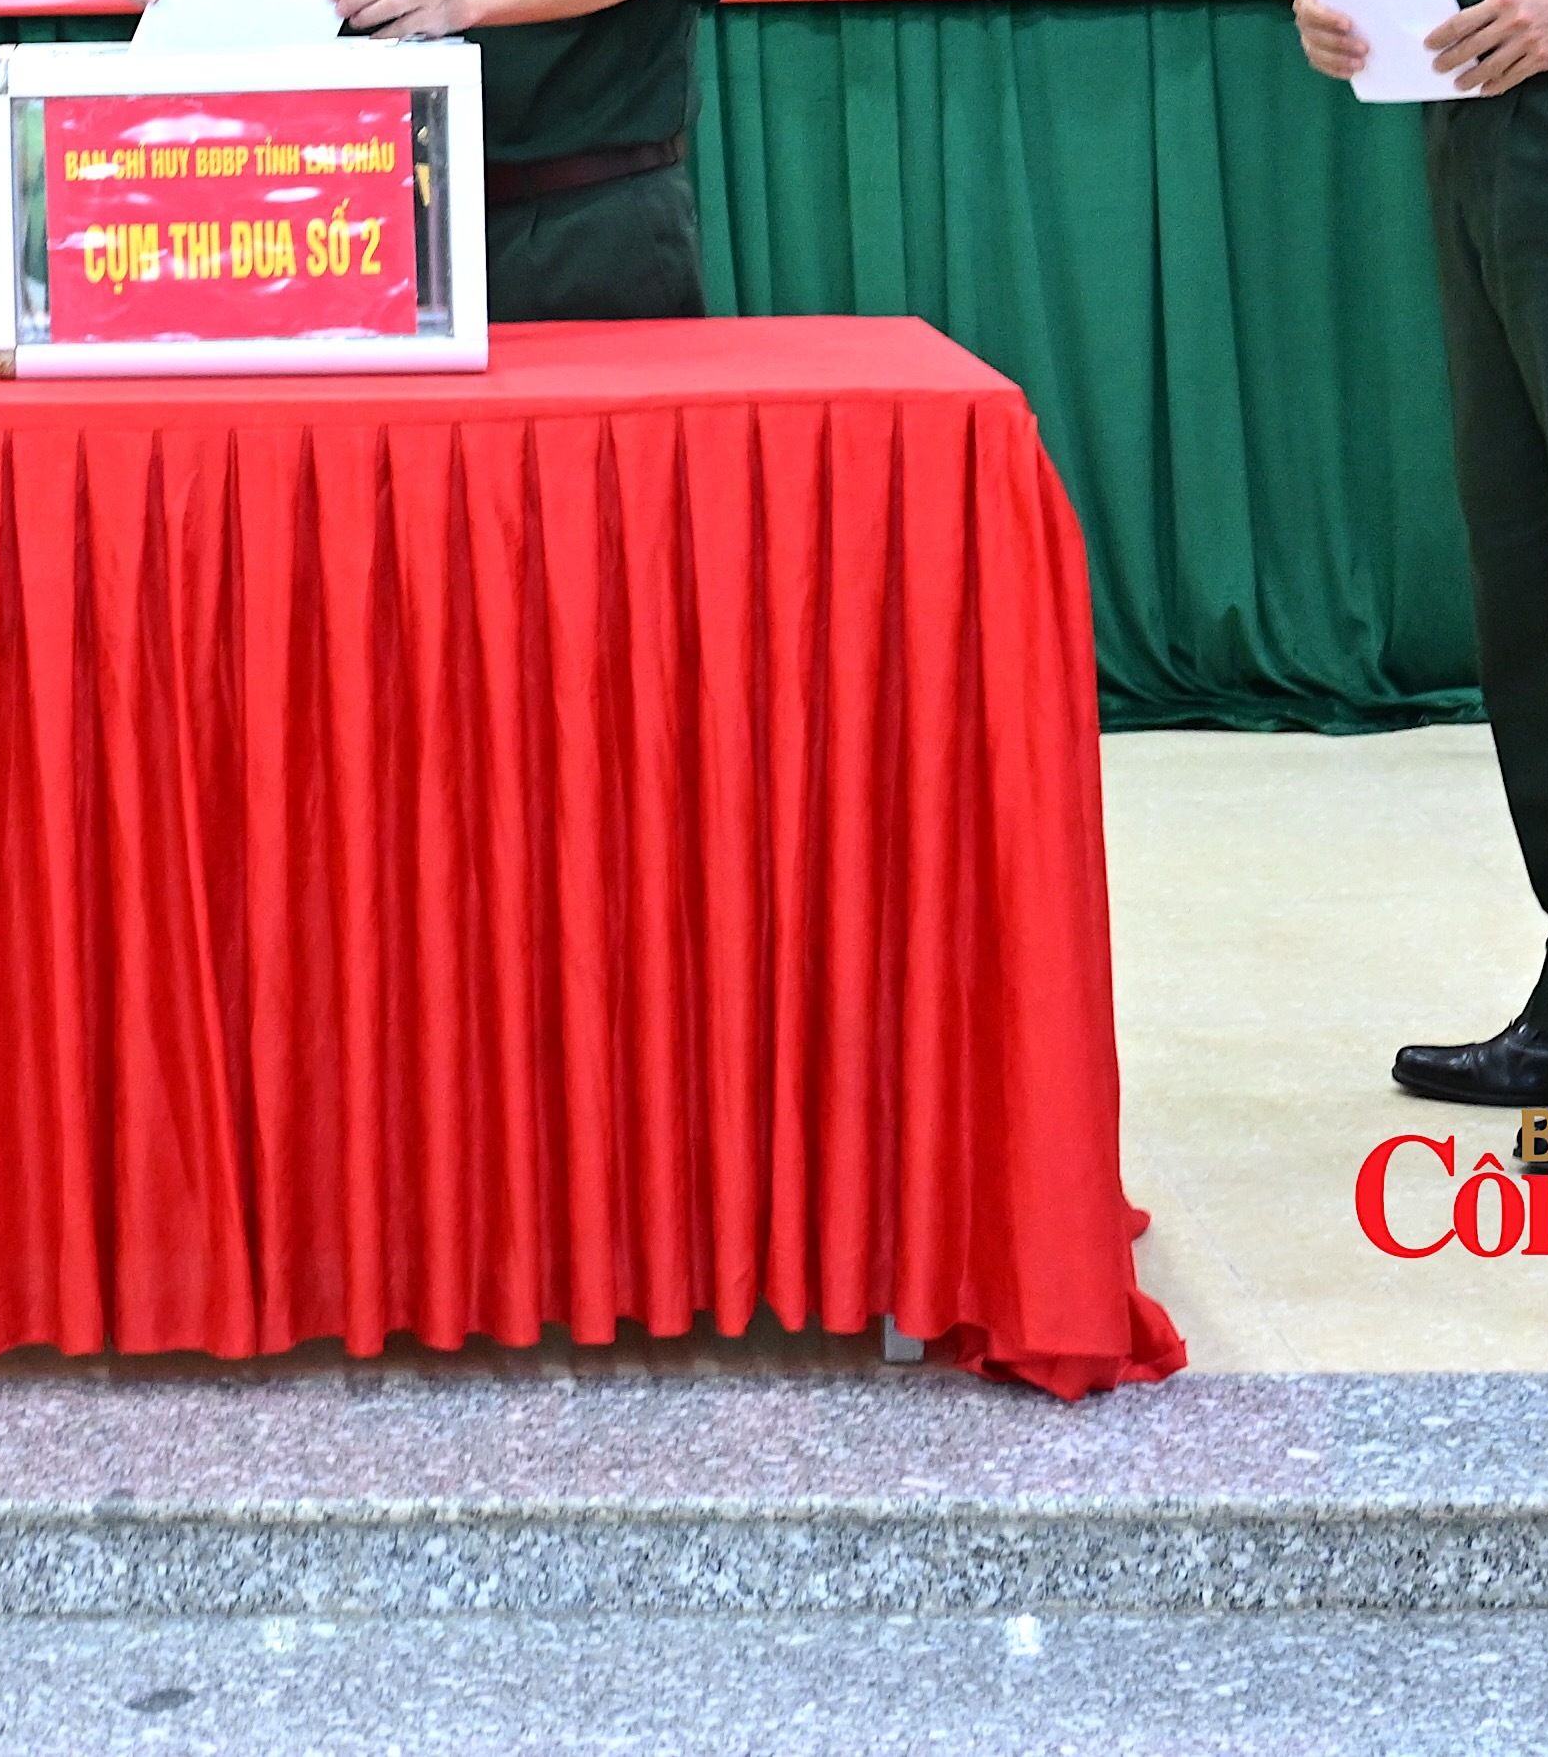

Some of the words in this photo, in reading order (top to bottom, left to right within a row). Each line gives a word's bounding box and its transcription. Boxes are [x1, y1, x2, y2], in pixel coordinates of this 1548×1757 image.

[151, 148, 190, 178] HUY
[254, 136, 300, 176] TỈNH
[341, 136, 395, 173] CHÂU
[83, 223, 159, 294] CỤM
[168, 222, 220, 279] THI
[231, 219, 296, 278] ĐUA
[306, 199, 351, 276] SỐ
[360, 219, 382, 275] 2
